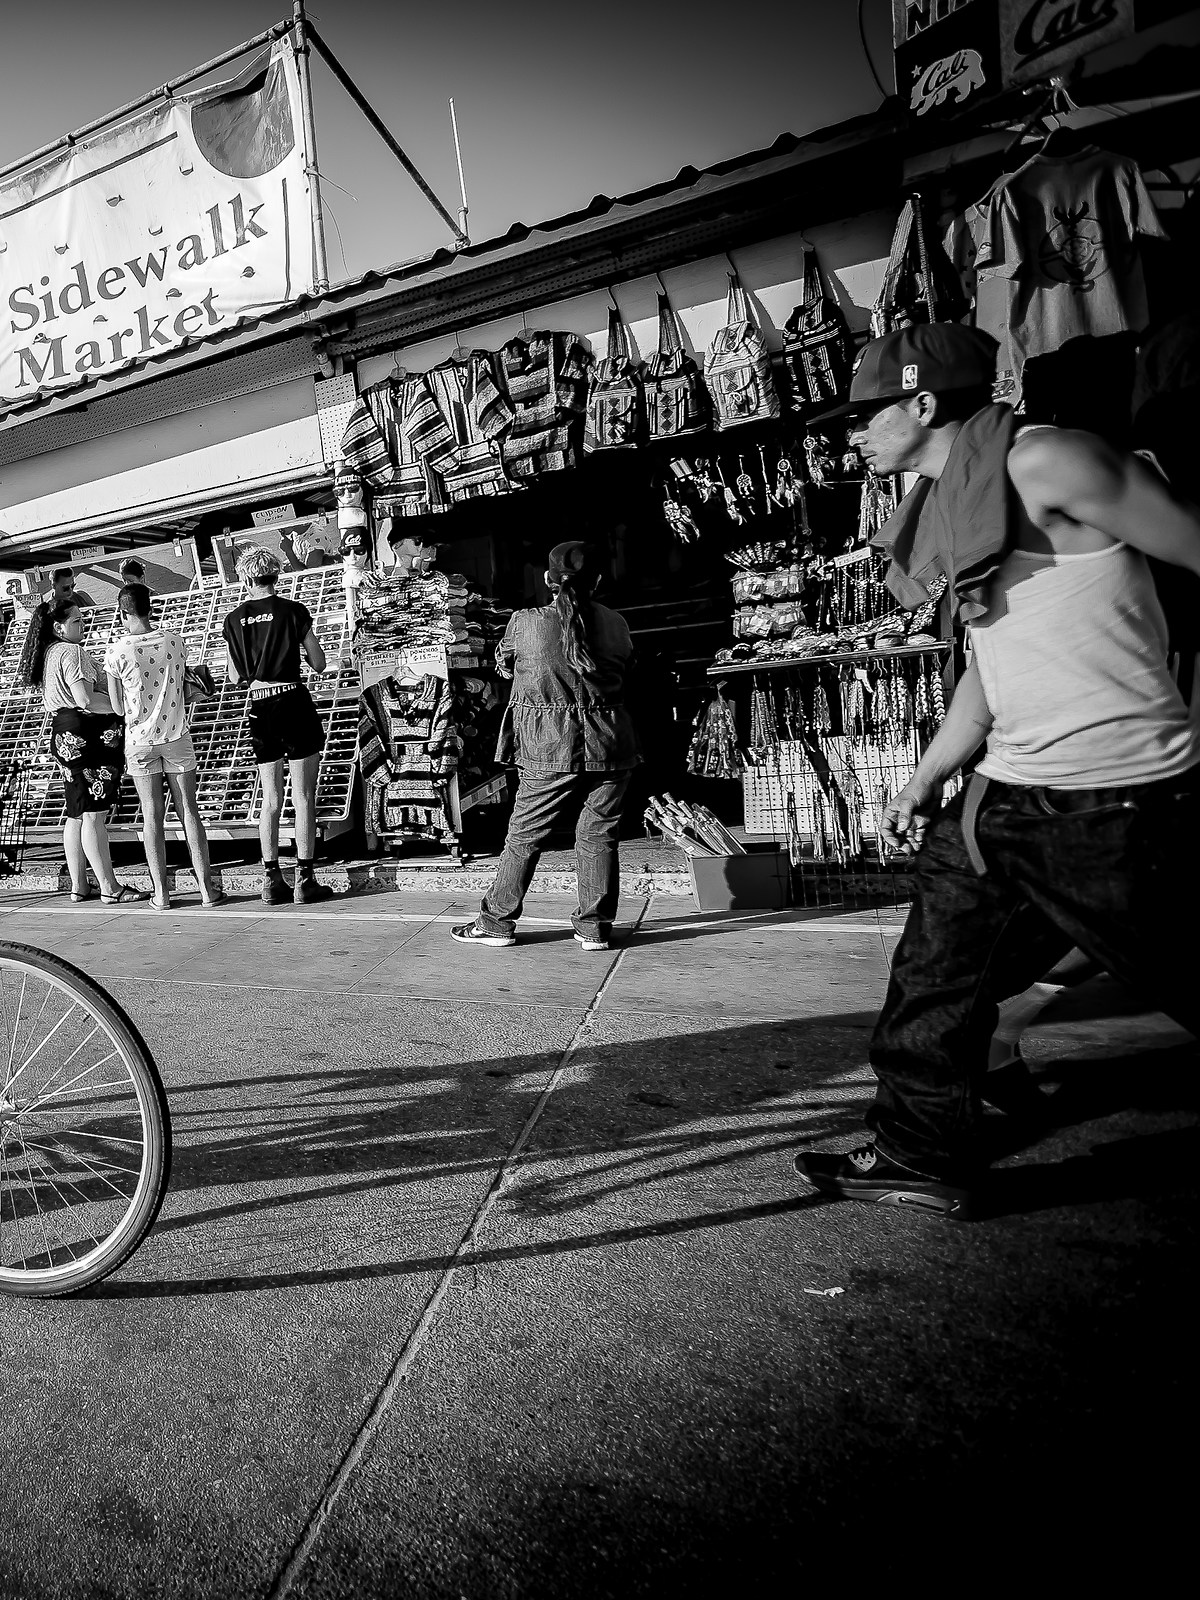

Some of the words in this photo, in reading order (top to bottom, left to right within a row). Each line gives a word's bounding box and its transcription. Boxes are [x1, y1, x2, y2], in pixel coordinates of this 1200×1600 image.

[921, 51, 968, 97] Cali
[8, 193, 268, 334] Sidewalk
[14, 287, 226, 387] Market
